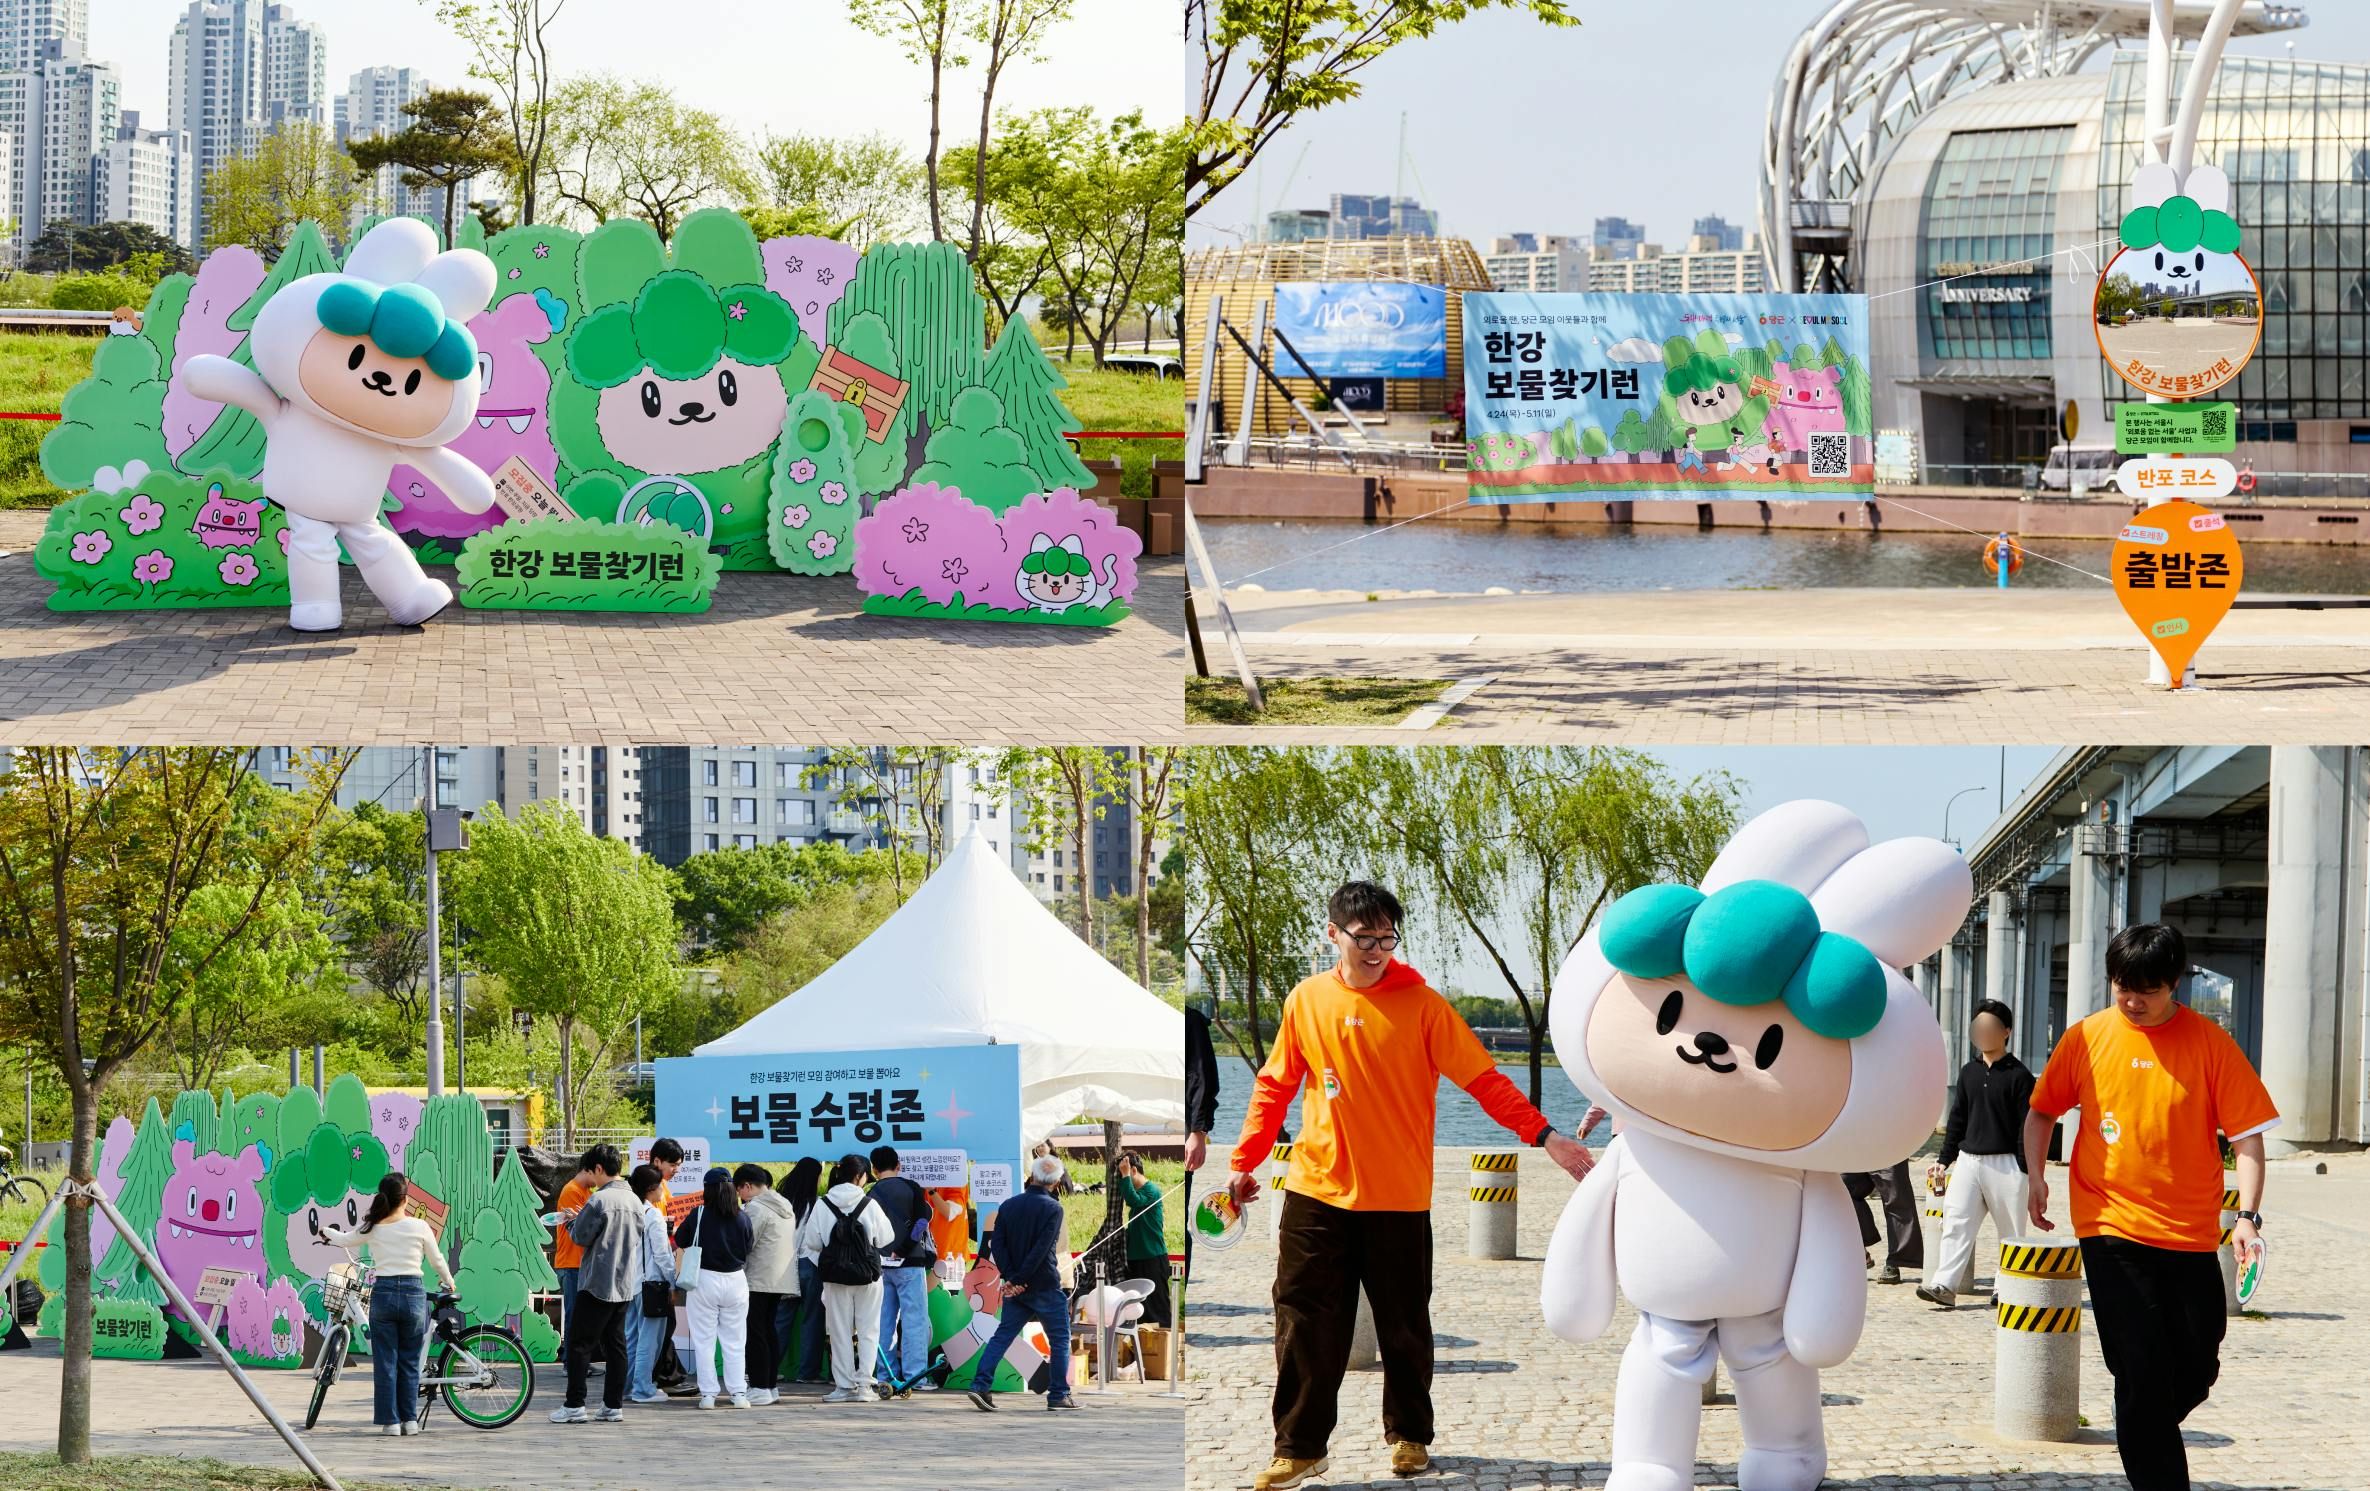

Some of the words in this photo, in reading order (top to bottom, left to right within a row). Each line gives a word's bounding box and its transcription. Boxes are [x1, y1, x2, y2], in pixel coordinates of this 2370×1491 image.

[1941, 281, 2032, 302] ANNIVERSARY
[1521, 315, 1537, 324] 당근
[1539, 315, 1555, 325] 모임
[1557, 315, 1588, 324] 이웃들과
[1591, 315, 1607, 324] 함께
[1769, 315, 1785, 324] 당근
[1484, 331, 1546, 363] 한강
[1485, 368, 1639, 401] 보물찾기런
[2126, 359, 2157, 385] 한강
[2157, 357, 2233, 392] 보물찾기런
[2126, 419, 2132, 427] 본
[2137, 468, 2174, 488] 반포
[2179, 468, 2216, 486] 코스
[508, 468, 534, 494] 모집중
[531, 492, 548, 511] 오늘
[489, 548, 544, 579] 한강
[549, 551, 684, 581] 보물찾기런
[2125, 551, 2230, 589] 출발존
[749, 1072, 765, 1084] 한강
[767, 1070, 806, 1083] 보물찾기런
[807, 1070, 823, 1082] 모임
[824, 1069, 857, 1082] 참여하고
[858, 1068, 874, 1080] 보물
[876, 1067, 901, 1079] 뽑아요
[728, 1092, 801, 1144] 보물
[809, 1089, 925, 1143] 수령존
[693, 1149, 702, 1161] 분
[95, 1318, 151, 1339] 보물찾기런
